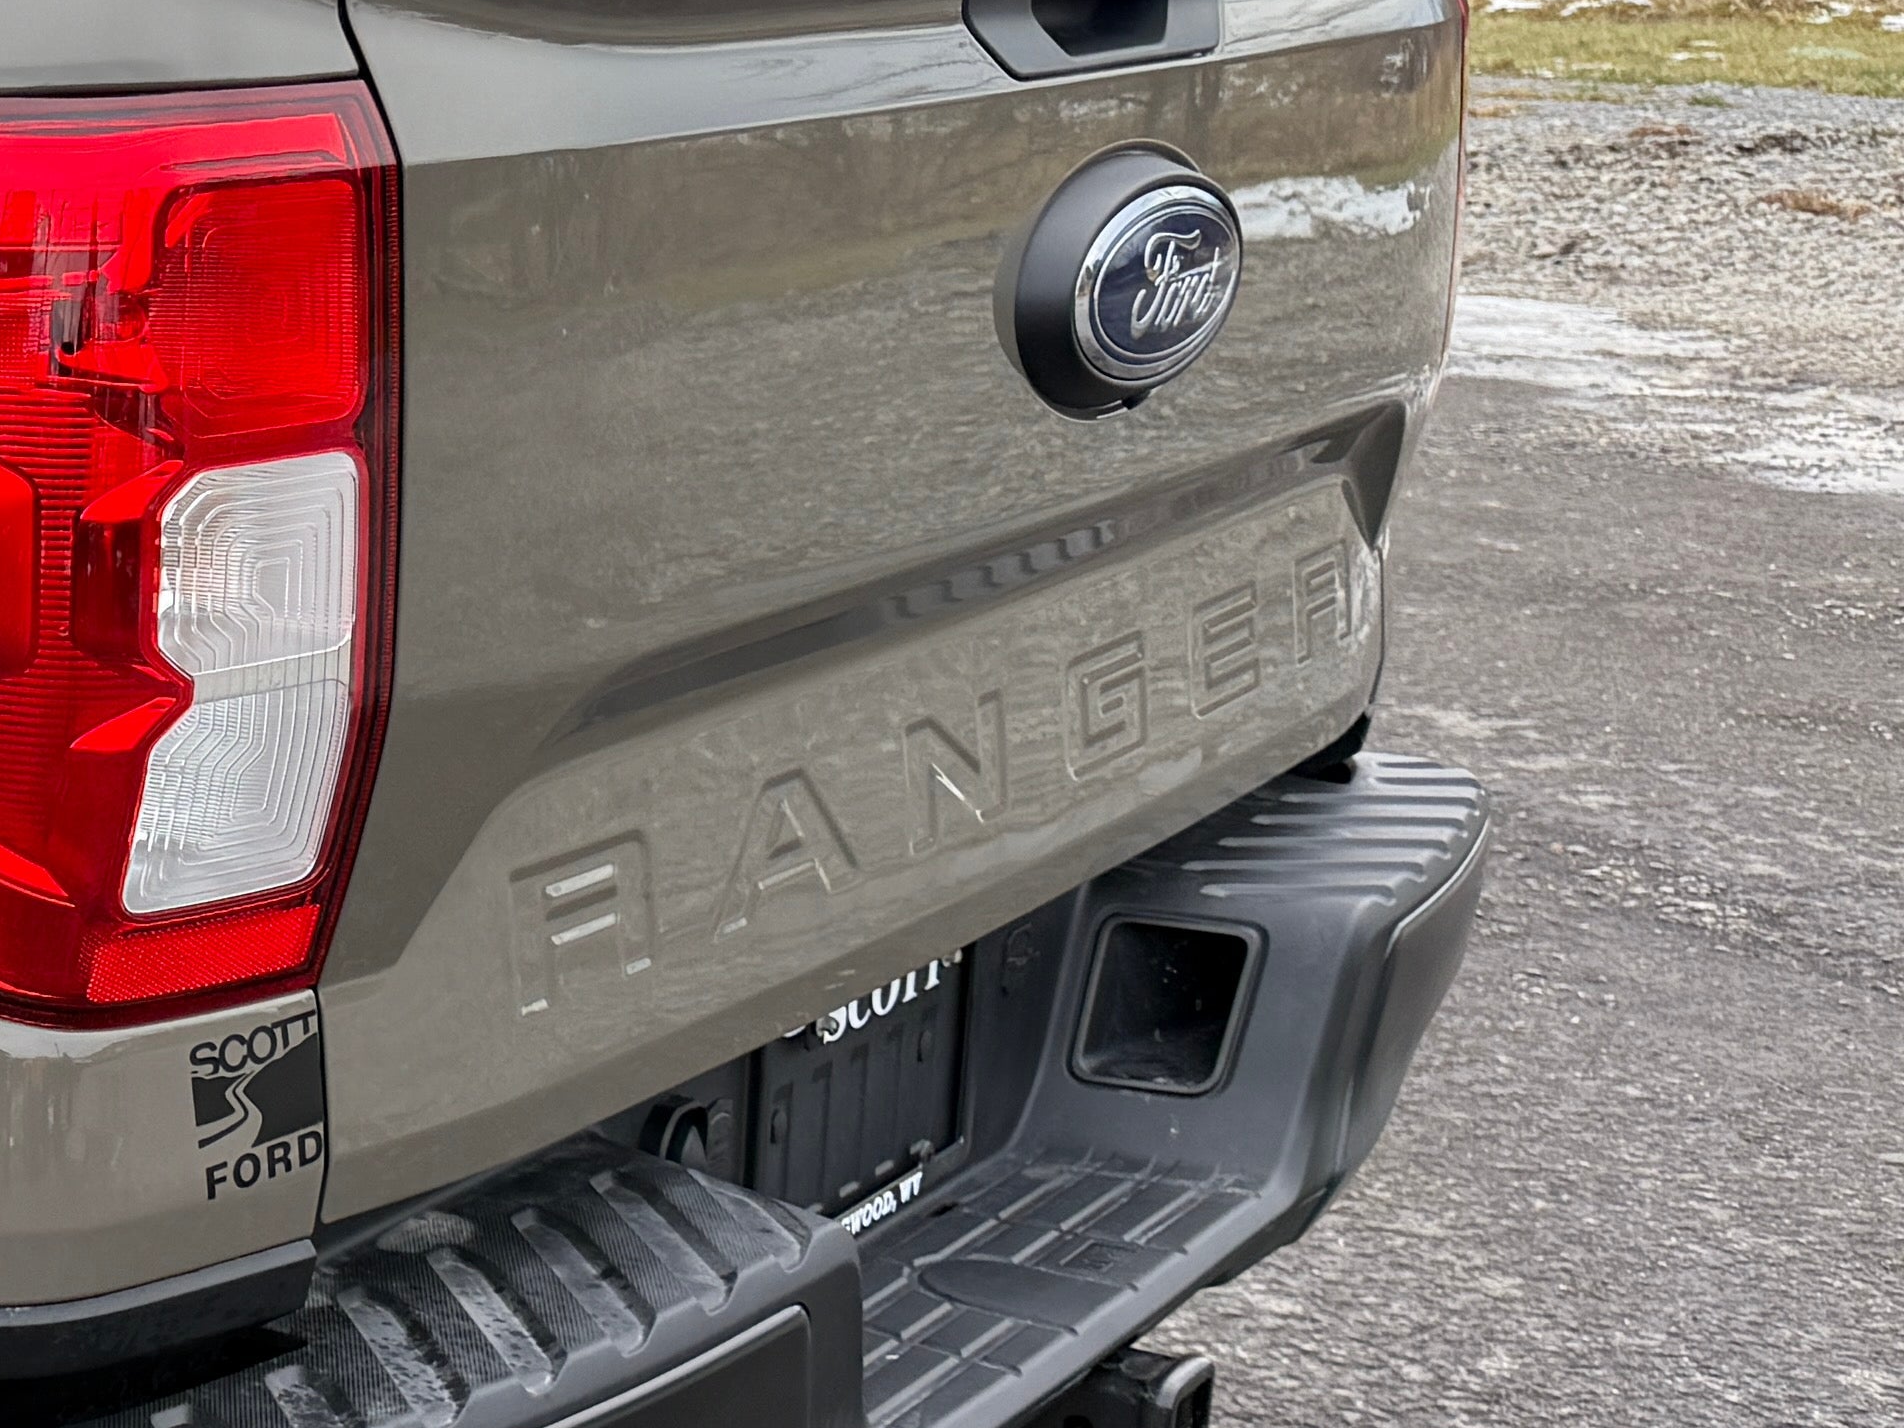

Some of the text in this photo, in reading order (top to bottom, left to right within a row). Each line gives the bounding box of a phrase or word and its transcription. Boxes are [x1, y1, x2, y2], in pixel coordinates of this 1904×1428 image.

[1130, 228, 1228, 340] Ford
[508, 538, 1355, 1016] RANGER
[189, 1008, 316, 1076] SCOTT
[205, 1129, 323, 1201] FORD
